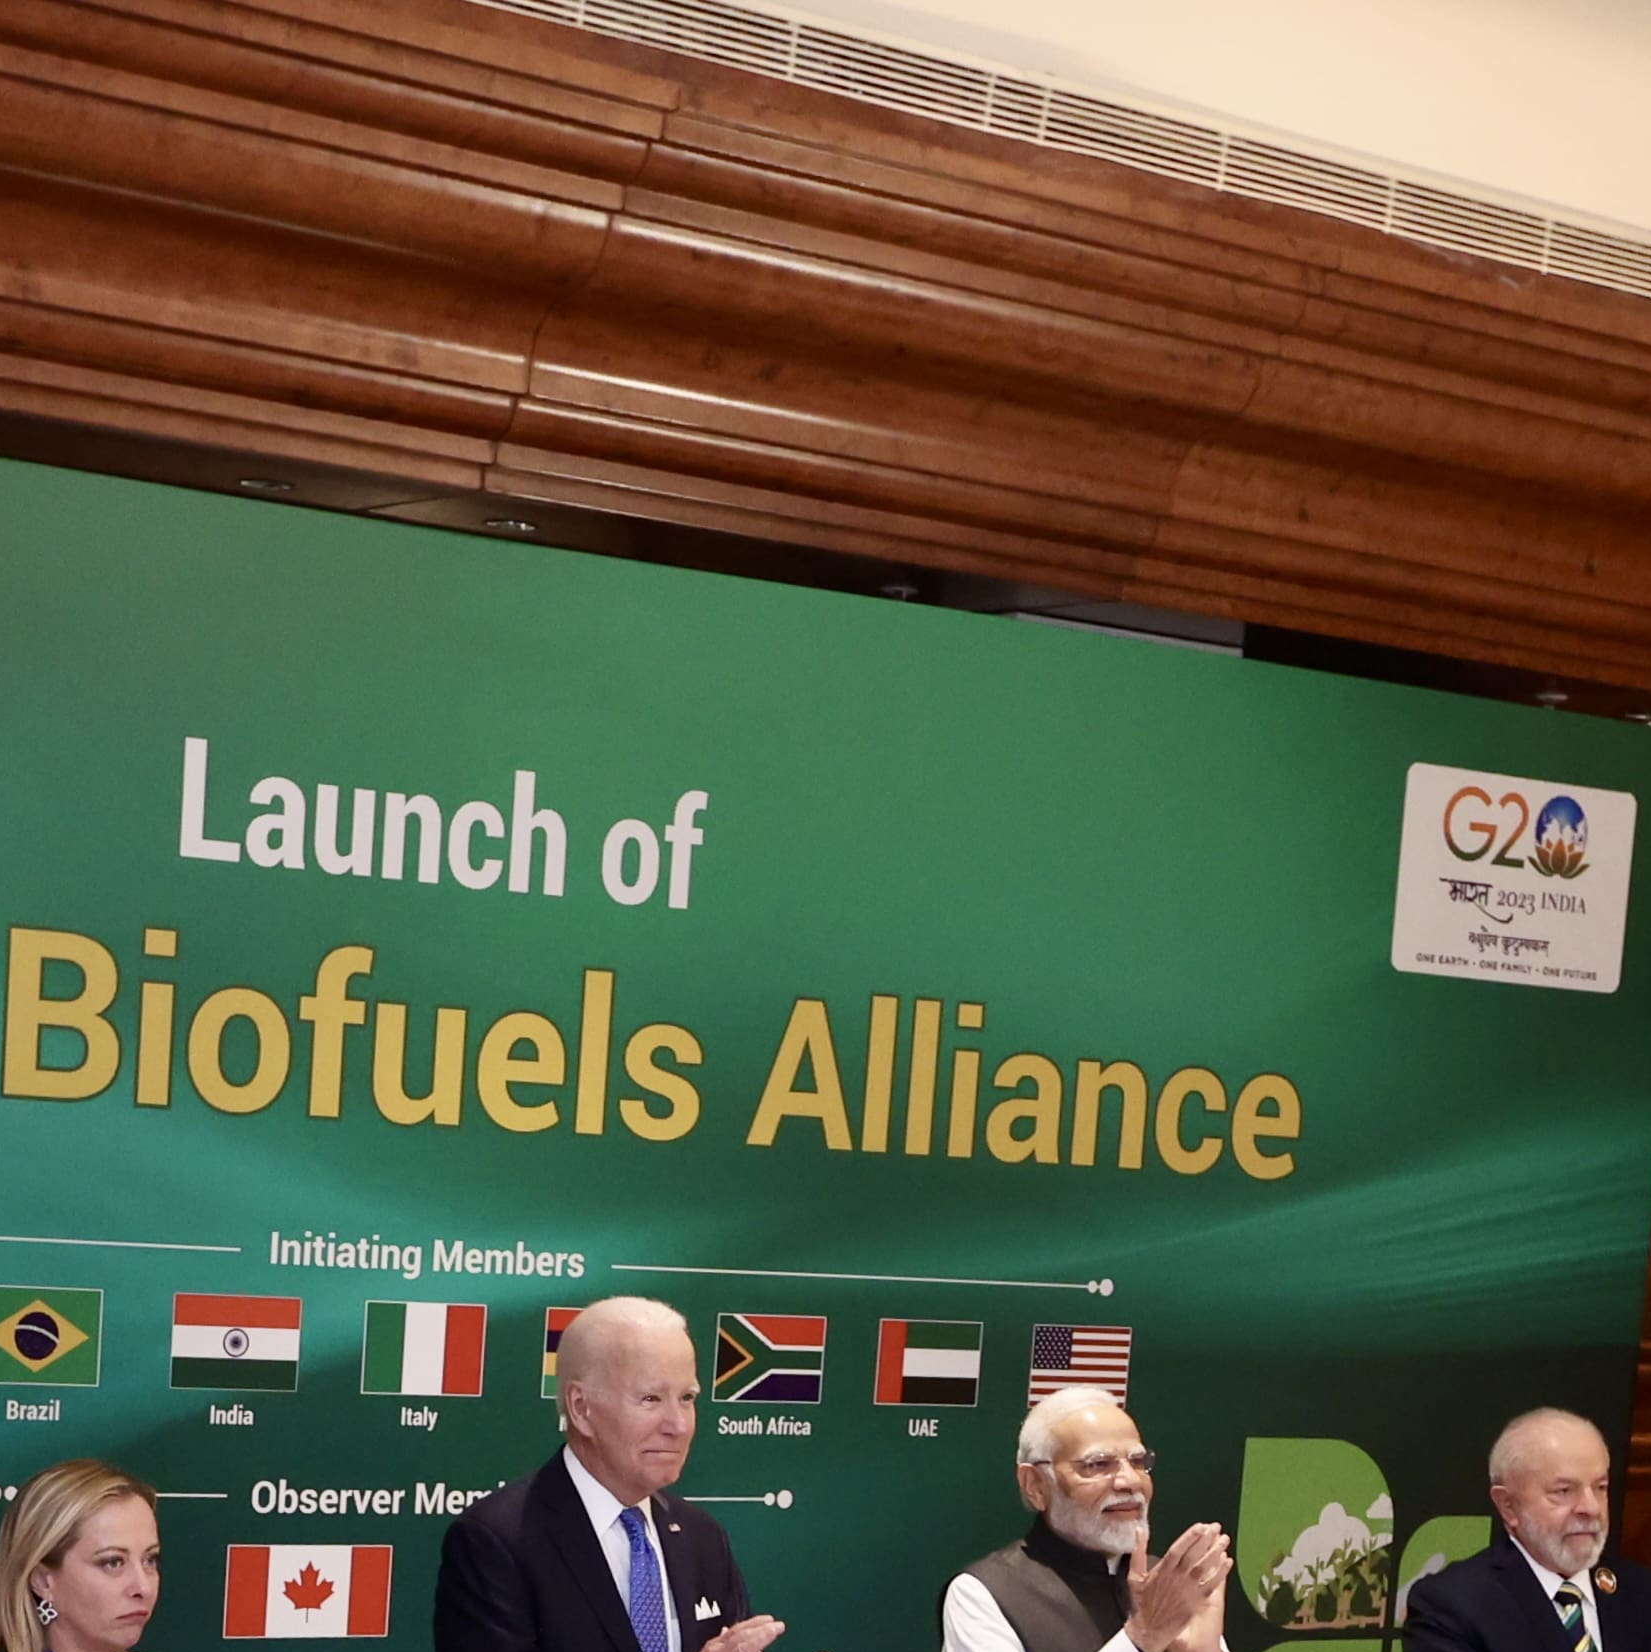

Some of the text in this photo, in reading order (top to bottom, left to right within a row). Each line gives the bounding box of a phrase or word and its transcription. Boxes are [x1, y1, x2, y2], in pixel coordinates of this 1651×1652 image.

[179, 736, 709, 910] Launch of
[1443, 786, 1590, 879] G20
[1497, 890, 1536, 915] 2023
[1541, 892, 1586, 914] INDIA
[1416, 952, 1597, 981] ONE EARTH ONE FAMILY ONE FUTURE
[0, 925, 703, 1142] Biofuels
[745, 994, 1302, 1180] Alliance
[269, 1229, 586, 1278] Initiating Members
[5, 1399, 61, 1423] Brazil
[209, 1404, 254, 1427] India
[400, 1406, 438, 1432] Italy
[717, 1415, 812, 1437] South Africa
[908, 1419, 939, 1438] UAE
[251, 1478, 405, 1515] Observer
